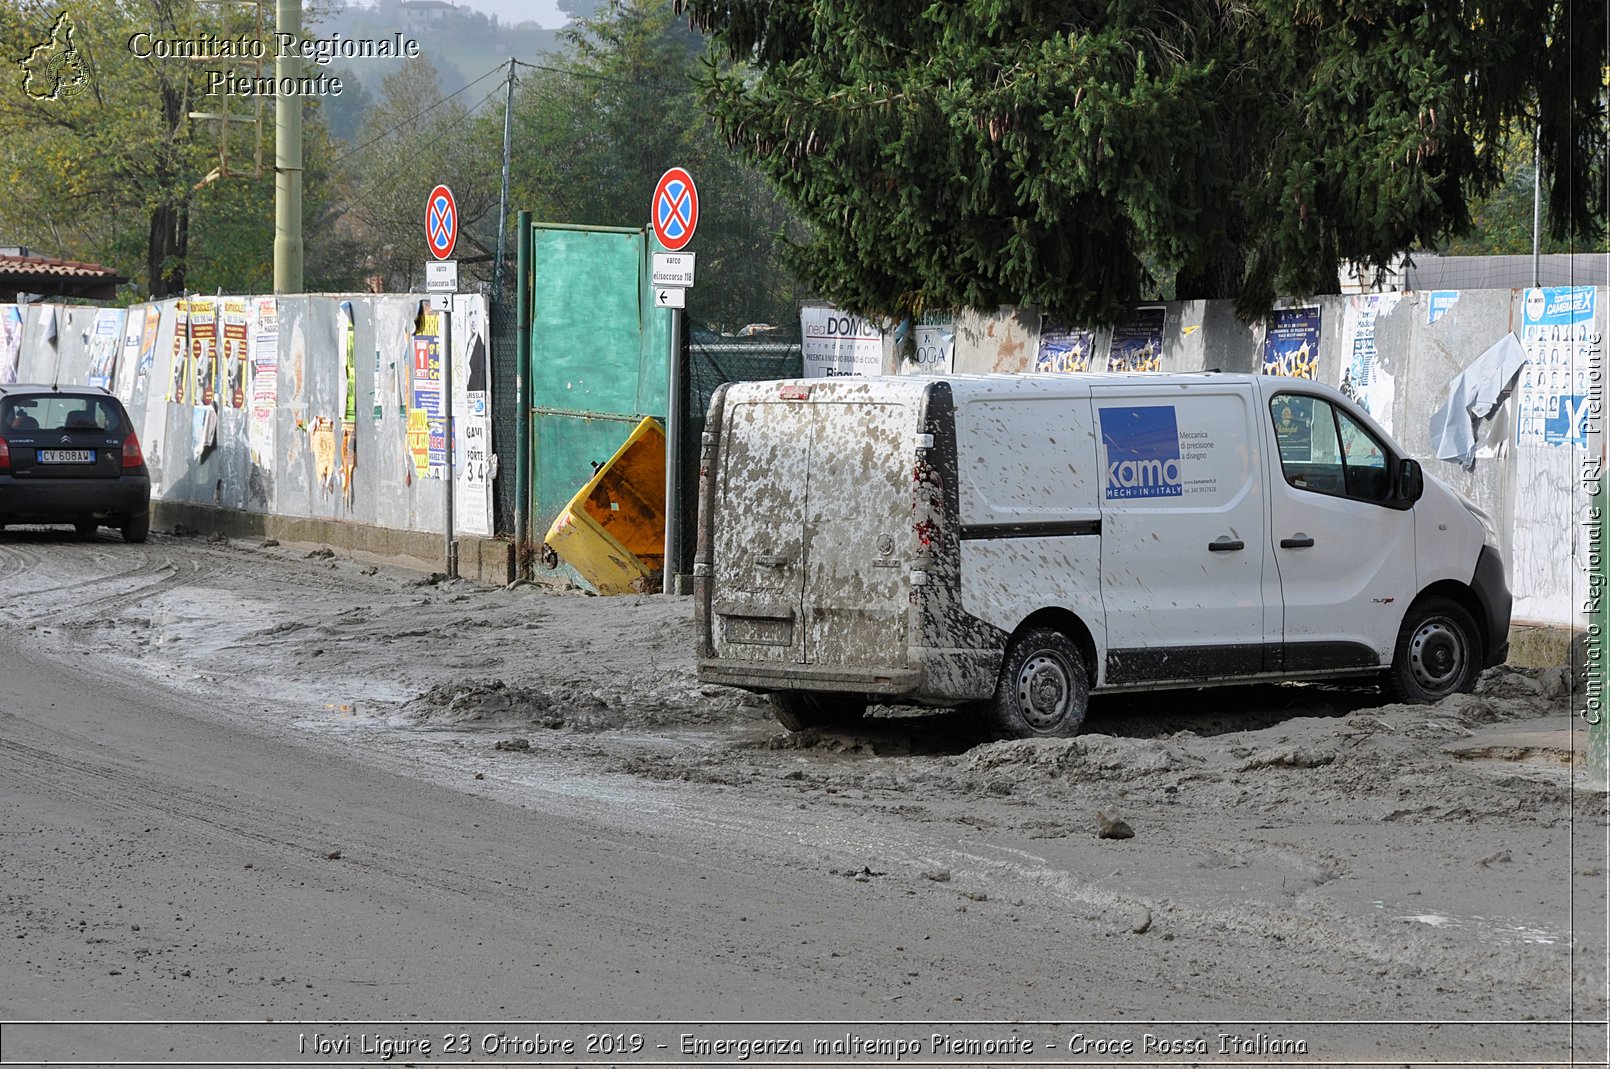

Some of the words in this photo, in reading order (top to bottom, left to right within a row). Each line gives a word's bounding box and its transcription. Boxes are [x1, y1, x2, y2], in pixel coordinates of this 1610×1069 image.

[666, 257, 681, 265] varco
[653, 270, 683, 281] elisoccorso
[806, 321, 825, 335] linea
[827, 317, 881, 337] DOMU
[917, 347, 946, 364] OGA
[466, 426, 483, 439] GAVI
[1180, 431, 1208, 440] Meccanica
[1187, 442, 1214, 450] precisione
[43, 451, 55, 461] CV
[60, 450, 89, 461] 608AW
[467, 450, 483, 460] FORTE
[1187, 452, 1207, 461] disegno
[468, 461, 473, 482] 3
[478, 463, 483, 482] 4
[1104, 444, 1182, 488] kama
[1107, 488, 1131, 497] MECH
[1140, 487, 1149, 496] IN
[1157, 486, 1183, 495] ITALY
